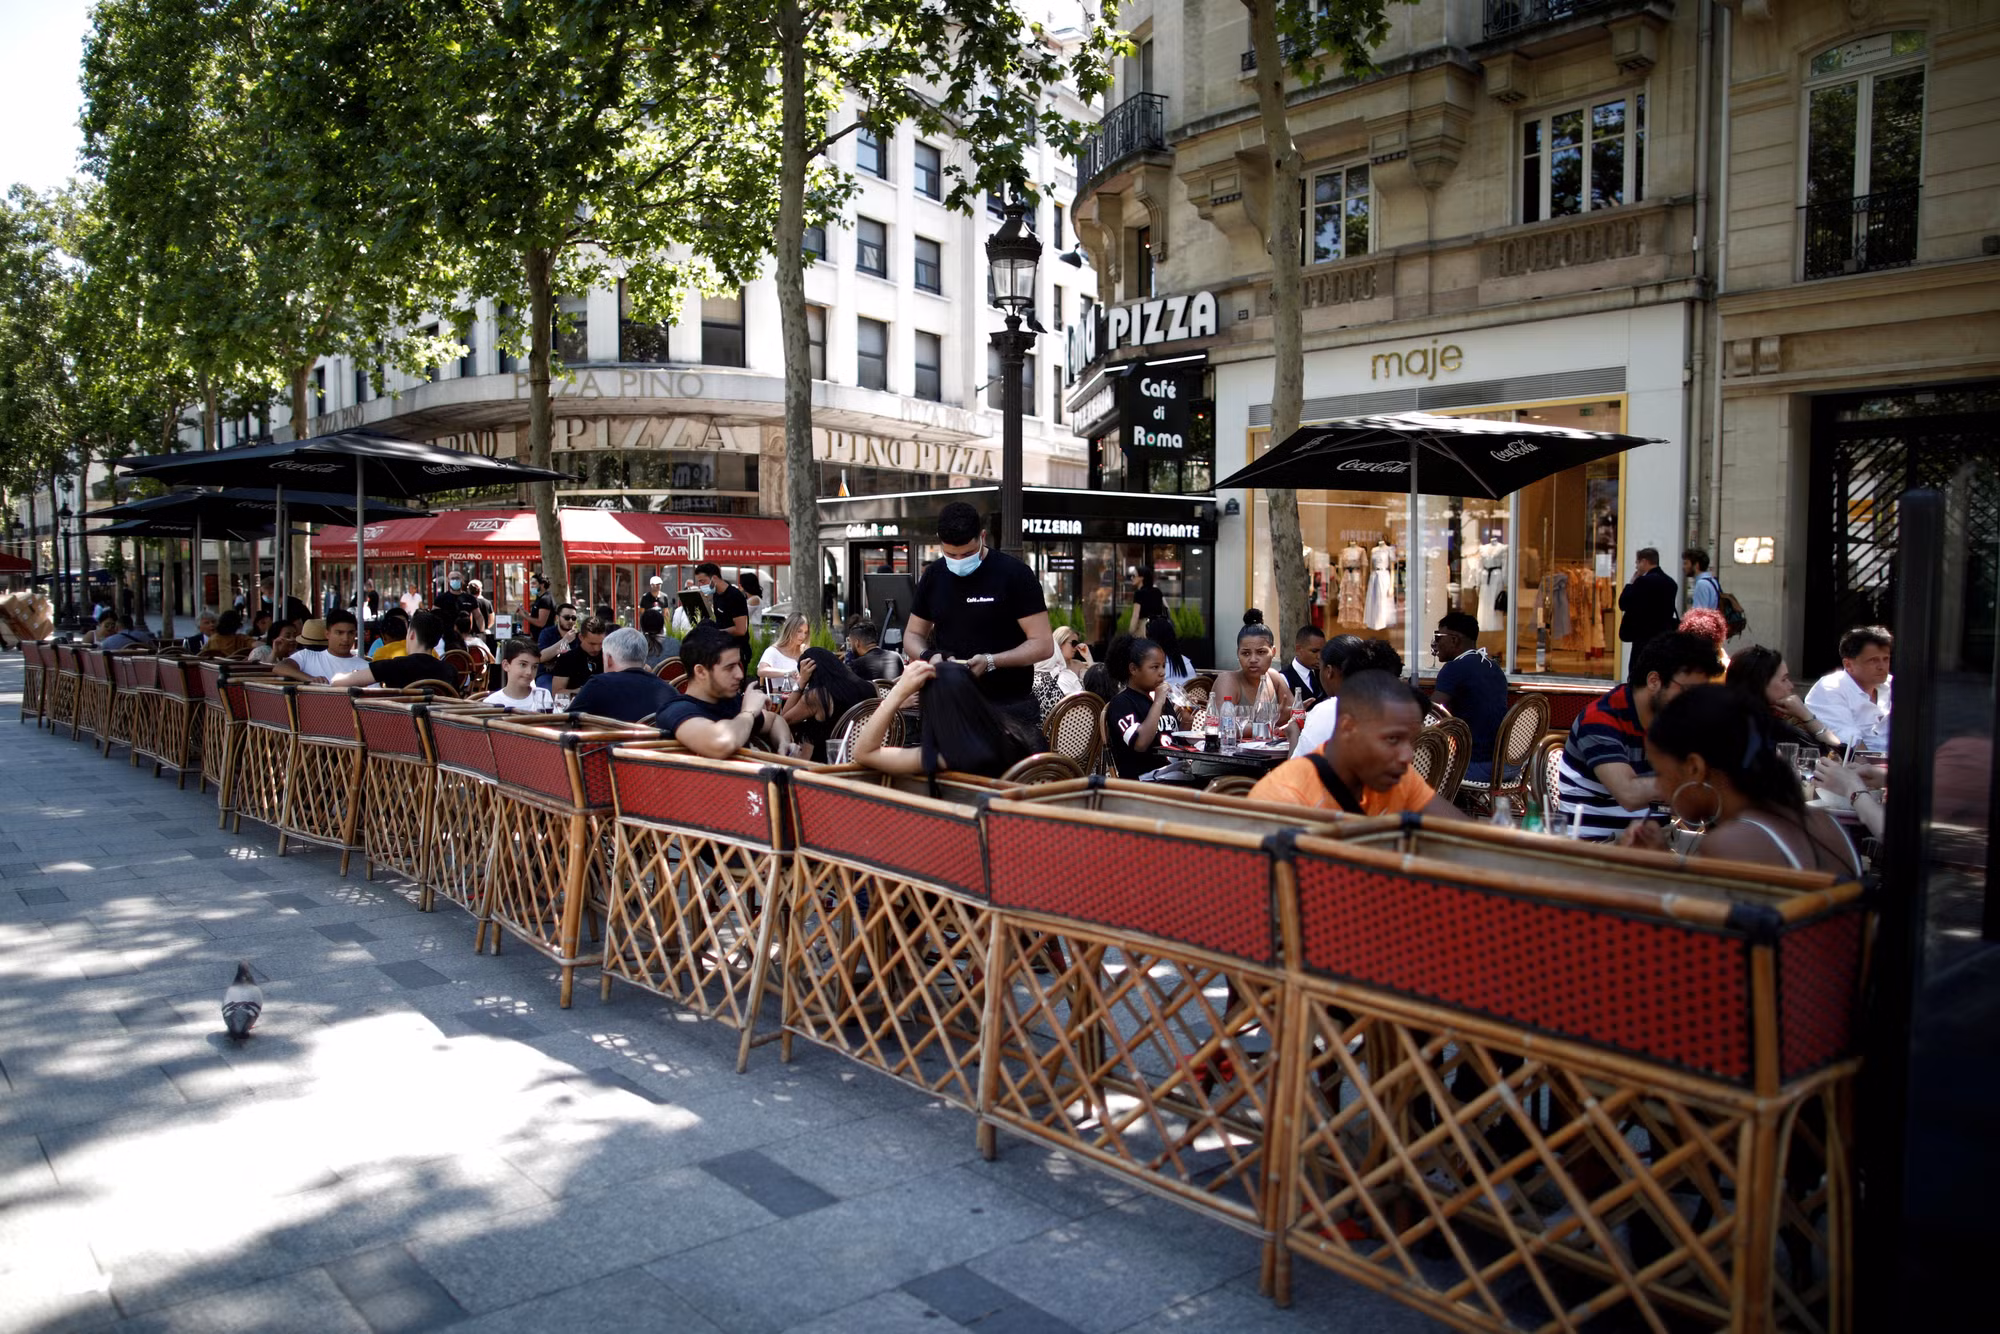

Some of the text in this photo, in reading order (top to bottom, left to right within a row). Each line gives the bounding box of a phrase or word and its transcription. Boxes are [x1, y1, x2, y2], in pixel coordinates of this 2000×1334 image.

[1107, 290, 1216, 350] PIZZA
[1371, 339, 1463, 380] maje
[513, 370, 704, 399] PZA PINO
[1140, 377, 1176, 399] Café
[1153, 406, 1165, 420] di
[555, 415, 741, 451] PIZZA
[1134, 426, 1183, 449] Roma
[825, 429, 1002, 478] PINO PIZZA
[467, 521, 498, 530] PIZZA
[702, 527, 733, 538] PINO
[1022, 518, 1082, 534] PIZZERIA
[1127, 522, 1200, 538] RISTORANTE
[653, 545, 676, 556] PIZZA
